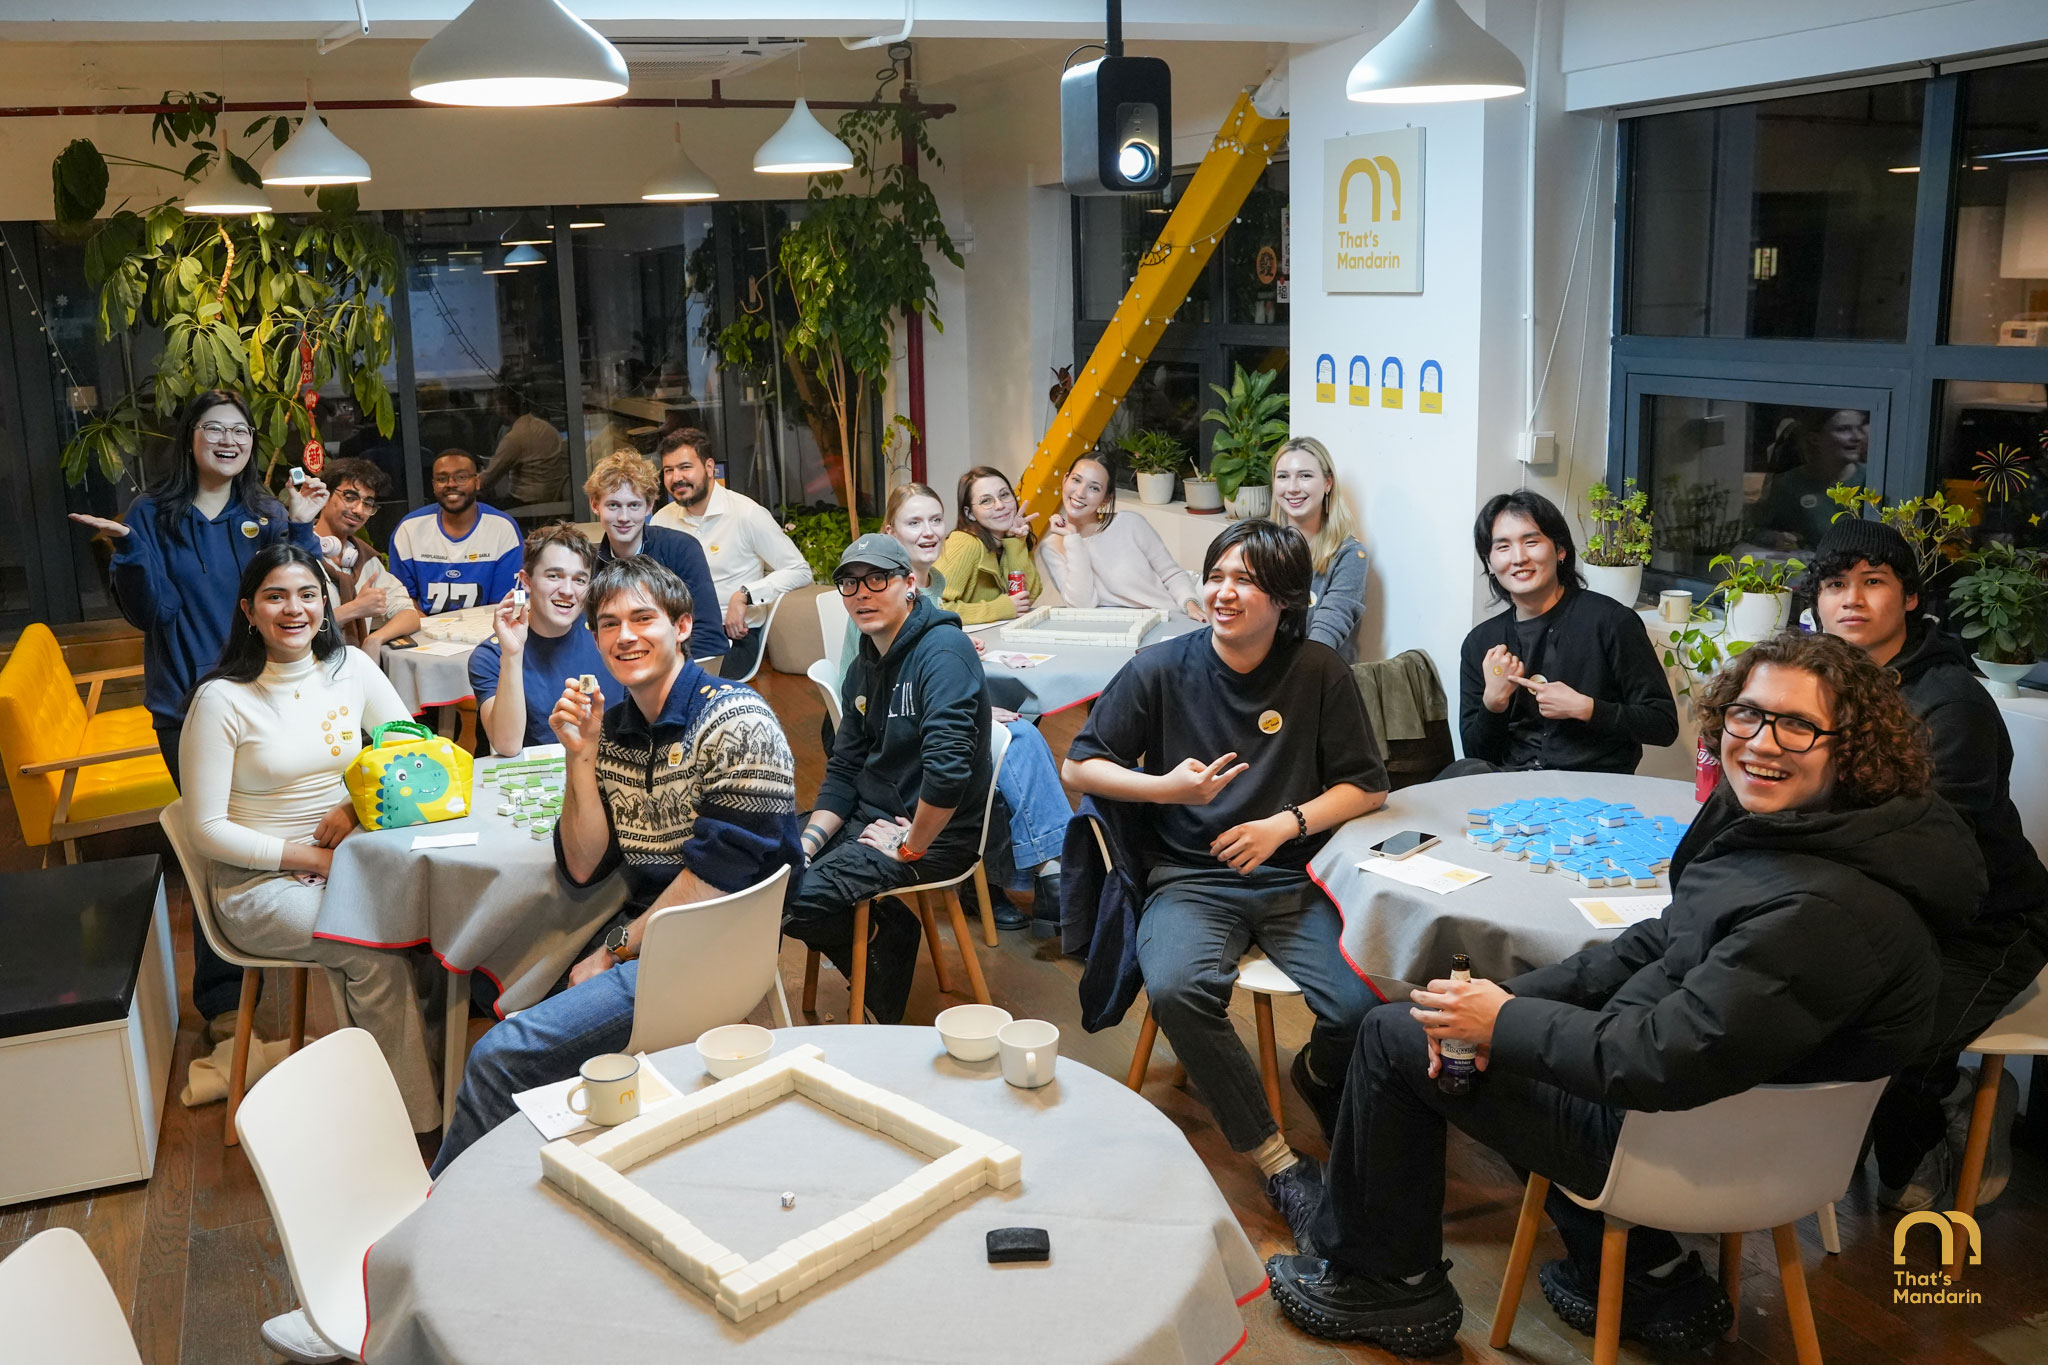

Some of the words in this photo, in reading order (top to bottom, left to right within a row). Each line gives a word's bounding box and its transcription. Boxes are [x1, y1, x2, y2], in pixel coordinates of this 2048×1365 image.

[1338, 230, 1379, 248] That's
[1337, 252, 1400, 270] Mandarin
[308, 446, 321, 466] 新
[427, 582, 479, 614] 77
